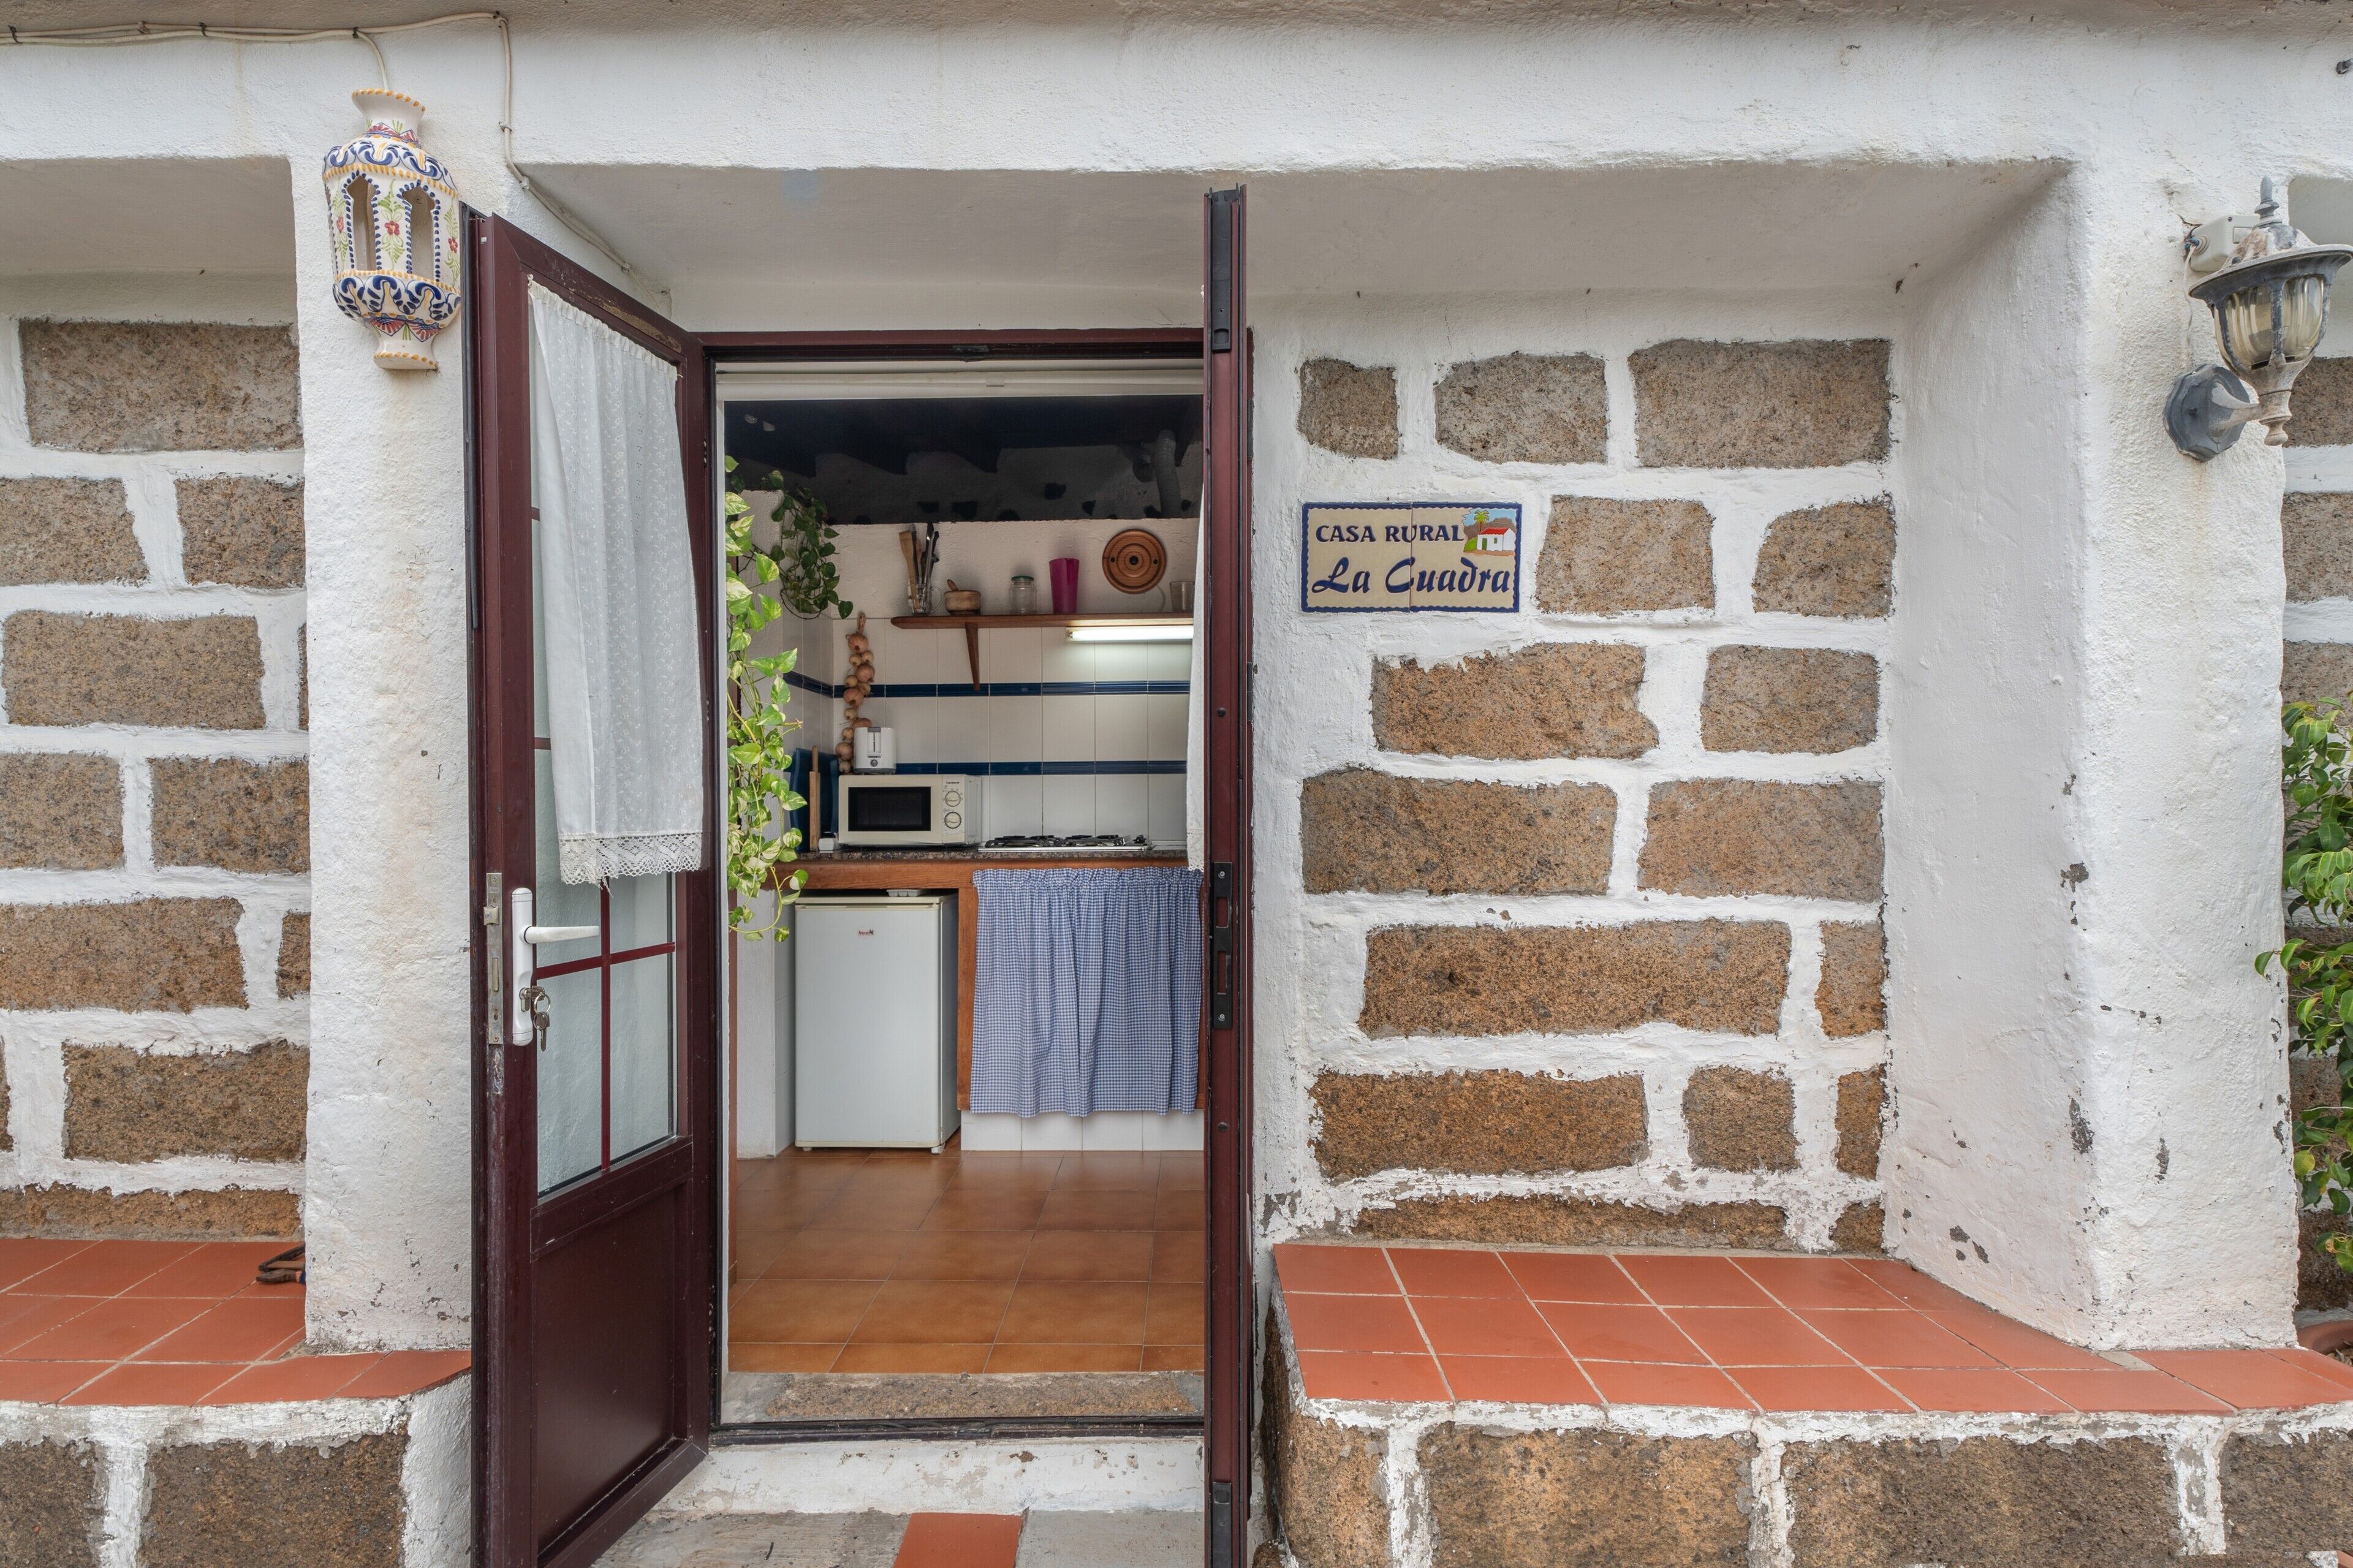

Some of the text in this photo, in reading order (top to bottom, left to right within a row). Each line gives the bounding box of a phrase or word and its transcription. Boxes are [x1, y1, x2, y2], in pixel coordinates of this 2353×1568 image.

[1316, 525, 1464, 542] CASA RURAL
[1311, 556, 1510, 593] La Cuadra
